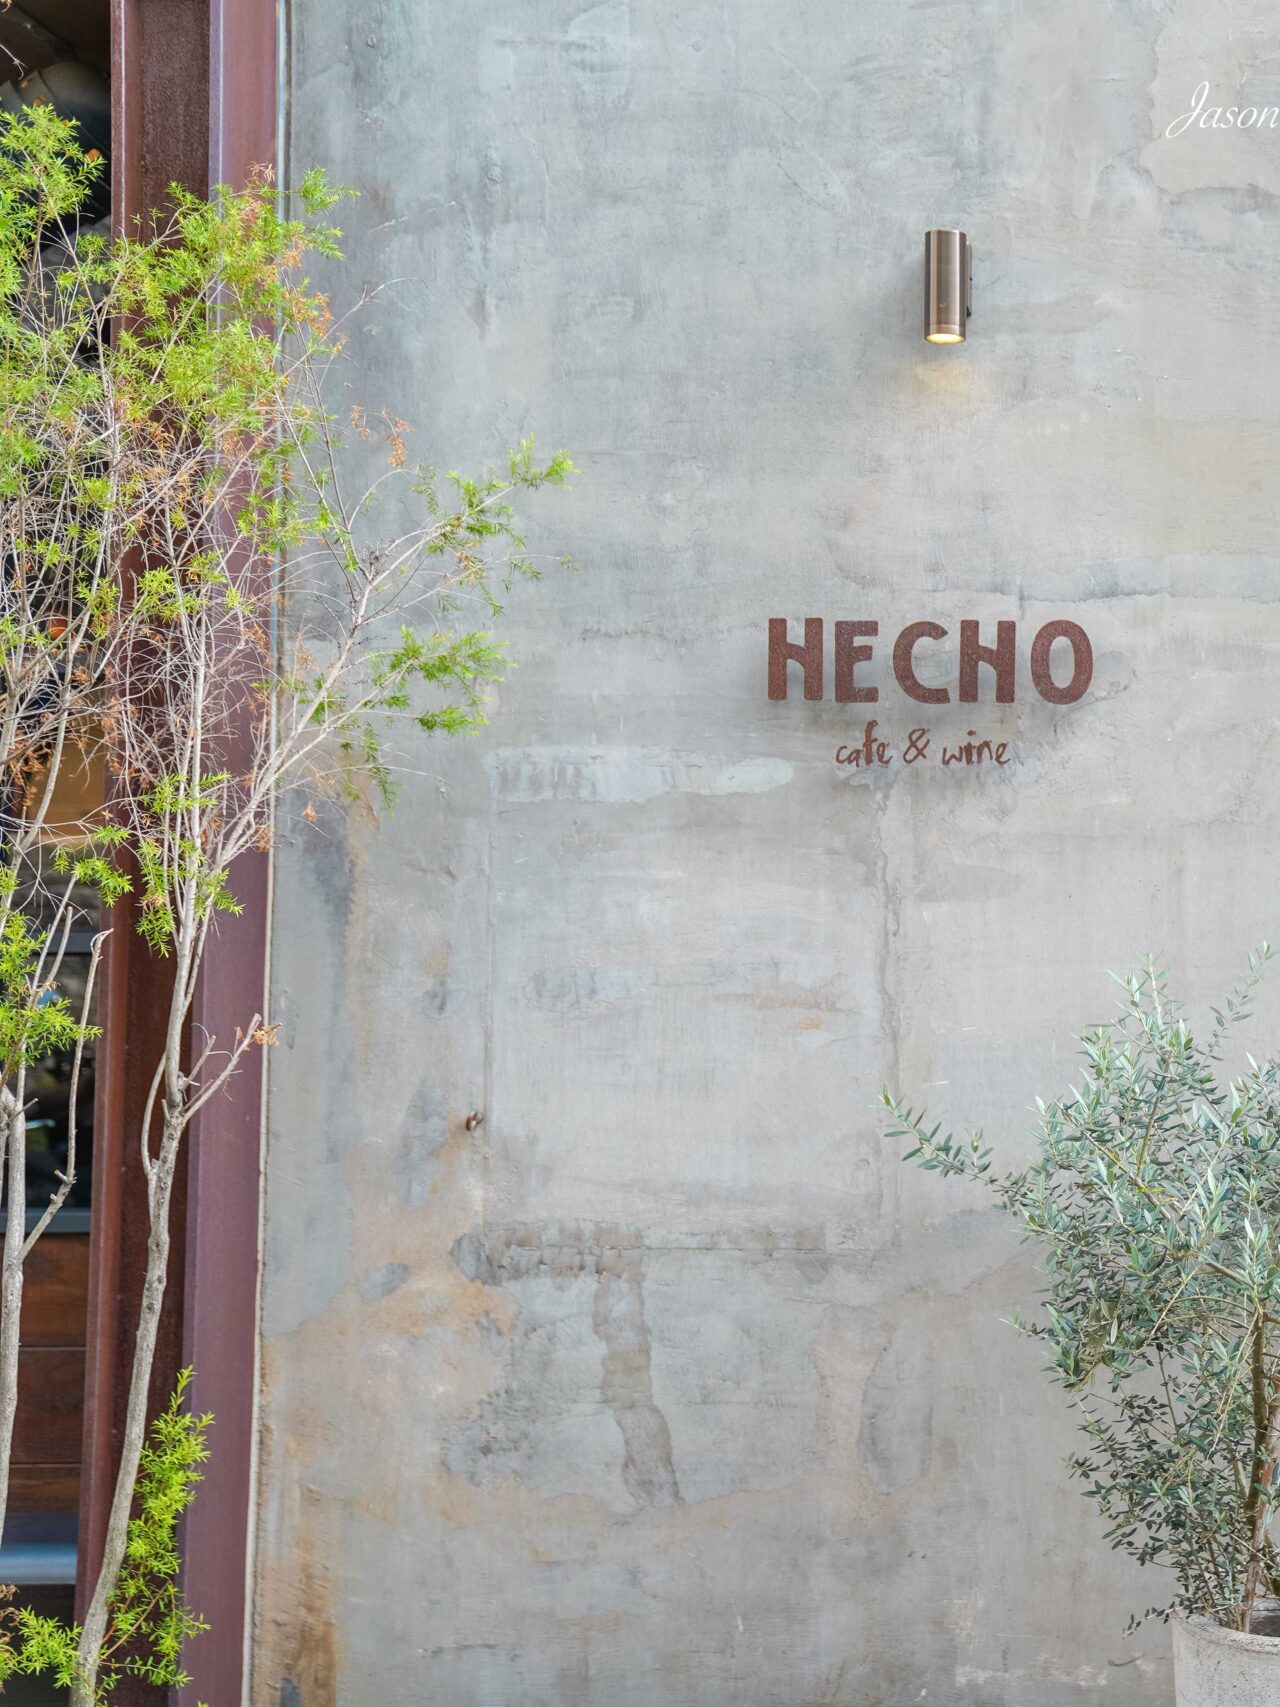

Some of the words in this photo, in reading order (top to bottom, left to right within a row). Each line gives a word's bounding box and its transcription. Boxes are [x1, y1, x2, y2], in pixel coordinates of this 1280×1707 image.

[768, 617, 1094, 705] HECHO
[835, 719, 894, 768] cafe
[903, 728, 930, 765] &
[941, 730, 1011, 765] wine
